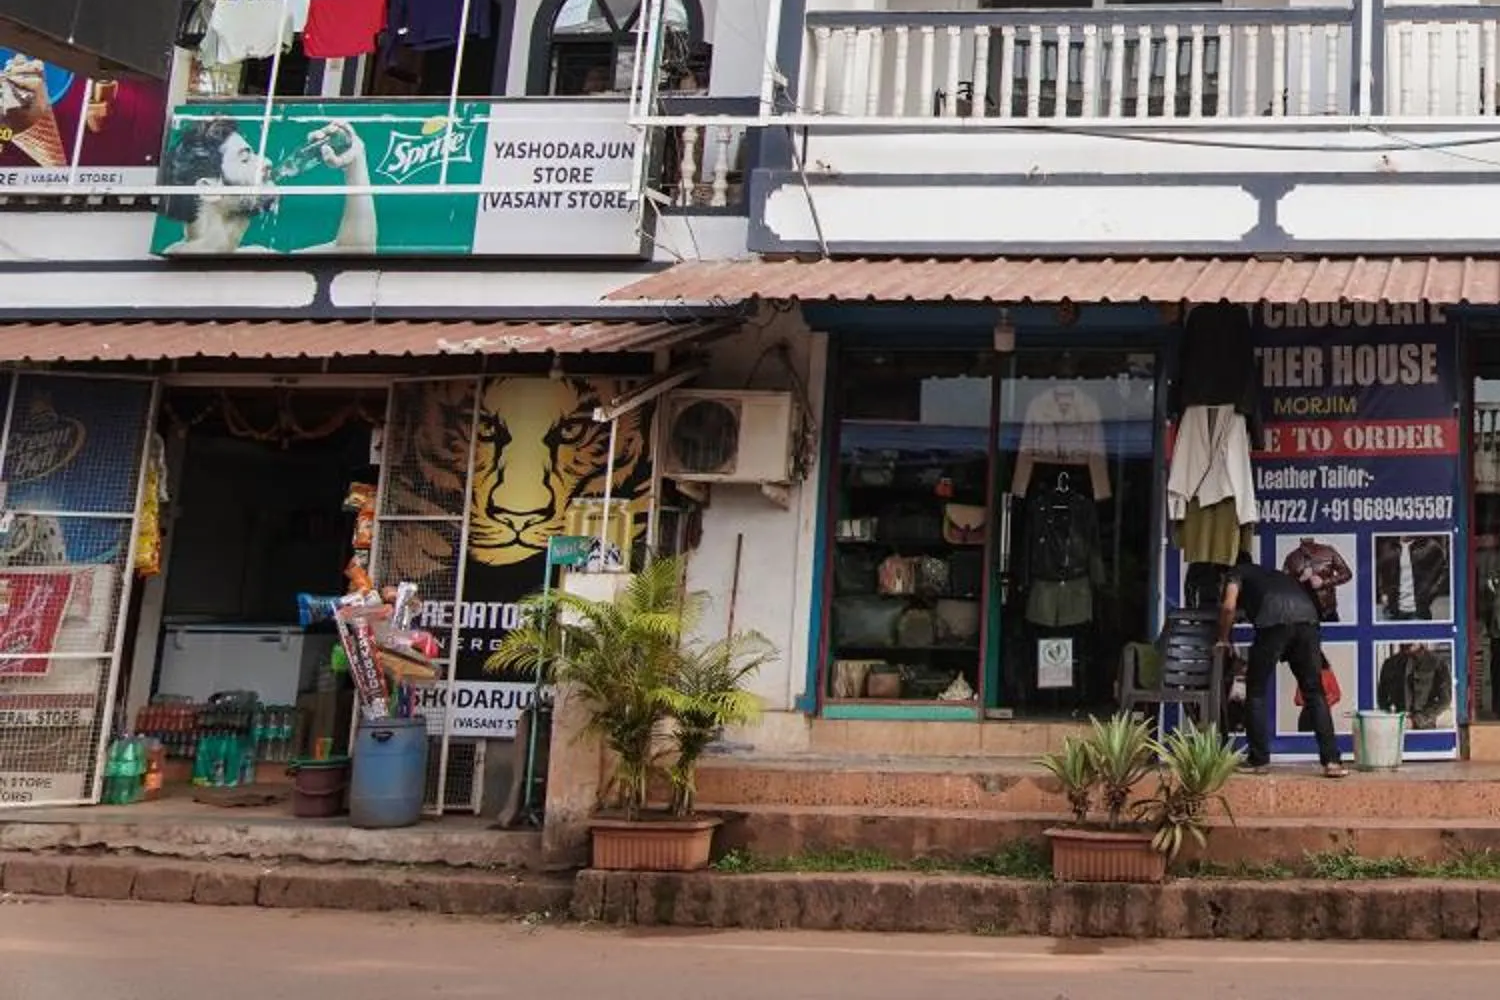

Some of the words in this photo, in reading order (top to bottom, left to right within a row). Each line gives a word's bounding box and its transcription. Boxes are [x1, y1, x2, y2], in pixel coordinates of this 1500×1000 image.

[494, 141, 635, 160] YASHODARJUN
[533, 166, 595, 184] STORE
[1331, 343, 1439, 386] HOUSE
[1273, 396, 1358, 415] MORJIM
[1291, 426, 1334, 452] TO
[1343, 423, 1445, 450] ORDER
[1257, 467, 1318, 490] Leather
[1321, 498, 1350, 522] +91
[1353, 495, 1454, 522] 9689435587
[36, 710, 80, 725] STORE
